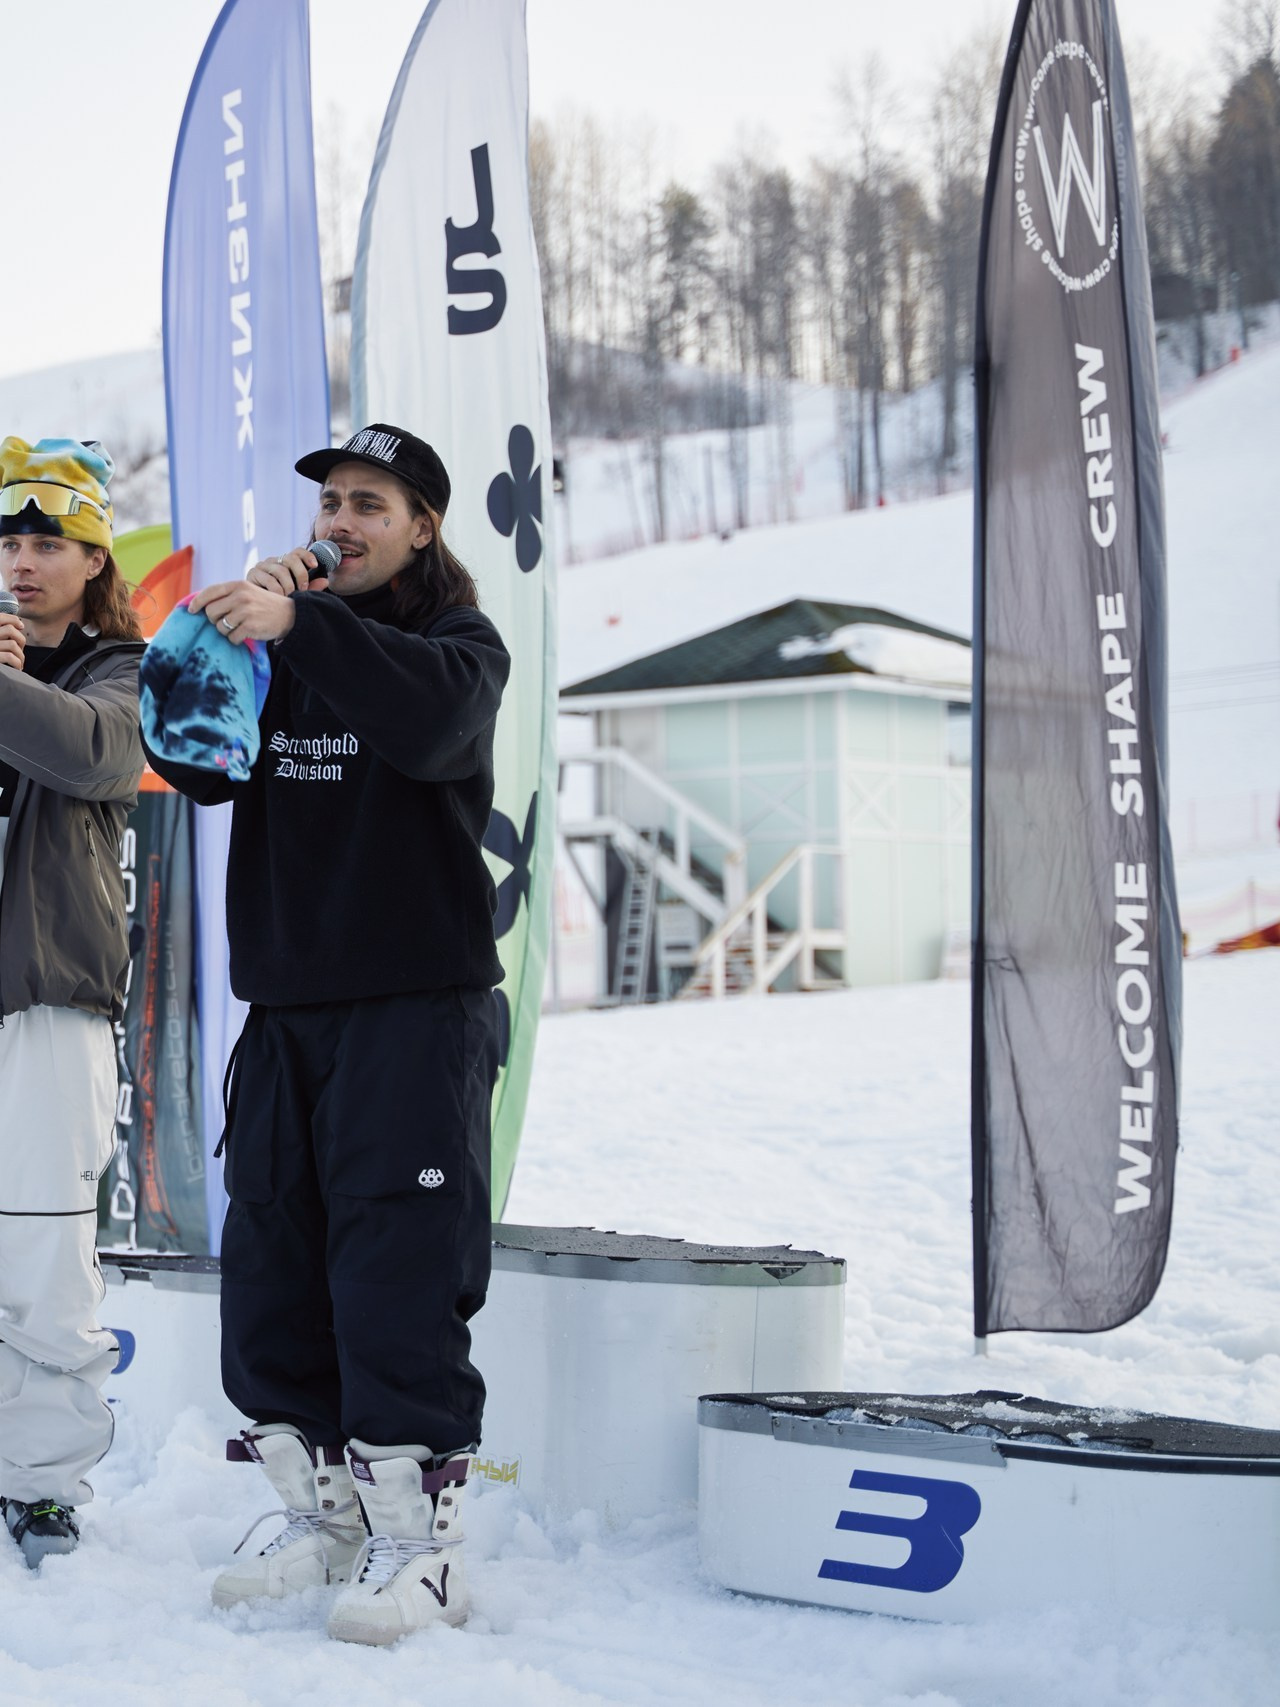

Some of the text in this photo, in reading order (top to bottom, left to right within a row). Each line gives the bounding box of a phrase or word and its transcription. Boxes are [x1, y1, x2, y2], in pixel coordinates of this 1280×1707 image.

[1014, 129, 1030, 183] crew
[1015, 189, 1044, 251] shape
[222, 88, 255, 451] ЖИЗНИ
[268, 731, 358, 760] Stronghold
[273, 757, 343, 781] Division
[1075, 342, 1155, 1214] WELCOME SHAPE CREW
[418, 1168, 445, 1185] 686
[817, 1468, 982, 1594] 3
